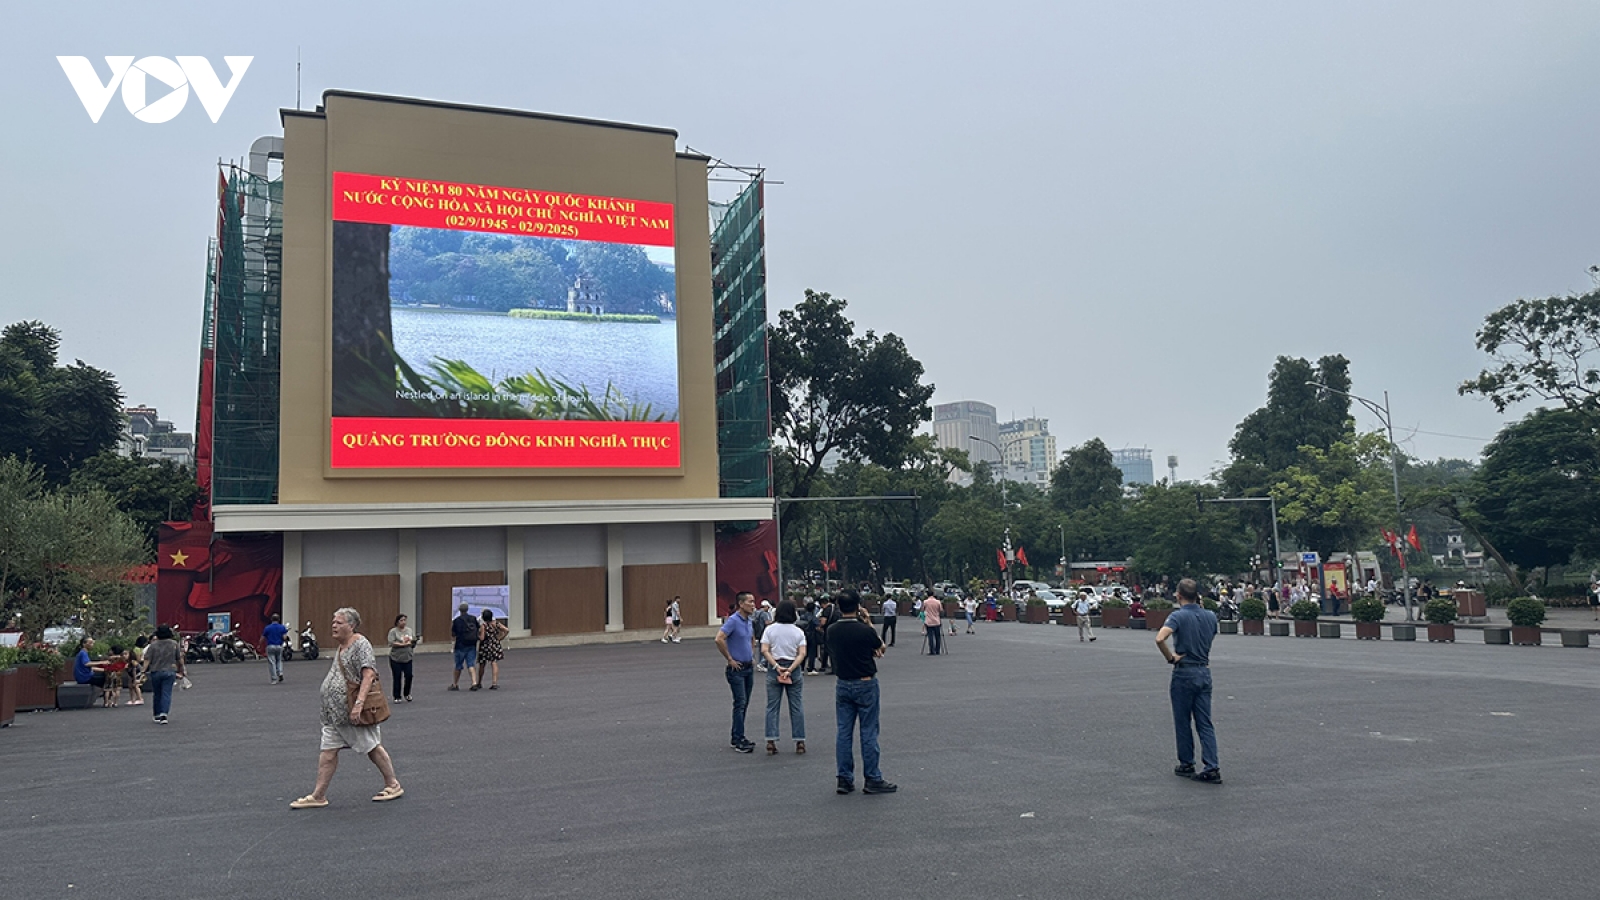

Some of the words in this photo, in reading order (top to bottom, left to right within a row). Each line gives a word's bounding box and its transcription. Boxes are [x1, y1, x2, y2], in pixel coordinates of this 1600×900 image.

[406, 181, 444, 196] NIỆM
[448, 185, 463, 196] 80
[466, 186, 498, 200] NĂM
[502, 189, 541, 204] NGÀY
[545, 193, 585, 208] QUỐC
[588, 197, 635, 213] KHÁNH
[343, 190, 388, 205] NƯỚC
[391, 194, 434, 209] CỘNG
[438, 198, 470, 212] HÒA
[474, 201, 493, 214] XÃ
[497, 204, 523, 218] HỘI
[526, 205, 556, 219] CHỦ
[560, 209, 603, 224] NGHĨA
[606, 214, 637, 228] VIỆT
[640, 218, 669, 230] NAM
[445, 214, 508, 230] (02/9/1945
[519, 220, 579, 237] 02/9/2025)
[395, 390, 432, 400] Nestled
[463, 391, 490, 401] island
[492, 391, 500, 401] in
[503, 392, 517, 401] the
[551, 392, 561, 402] of
[342, 431, 405, 449] QUẢNG
[409, 431, 481, 448] TRƯỜNG
[485, 431, 531, 448] ĐÔNG
[535, 435, 575, 448] KINH
[579, 433, 627, 448] NGHĨA
[631, 436, 671, 450] THỤC
